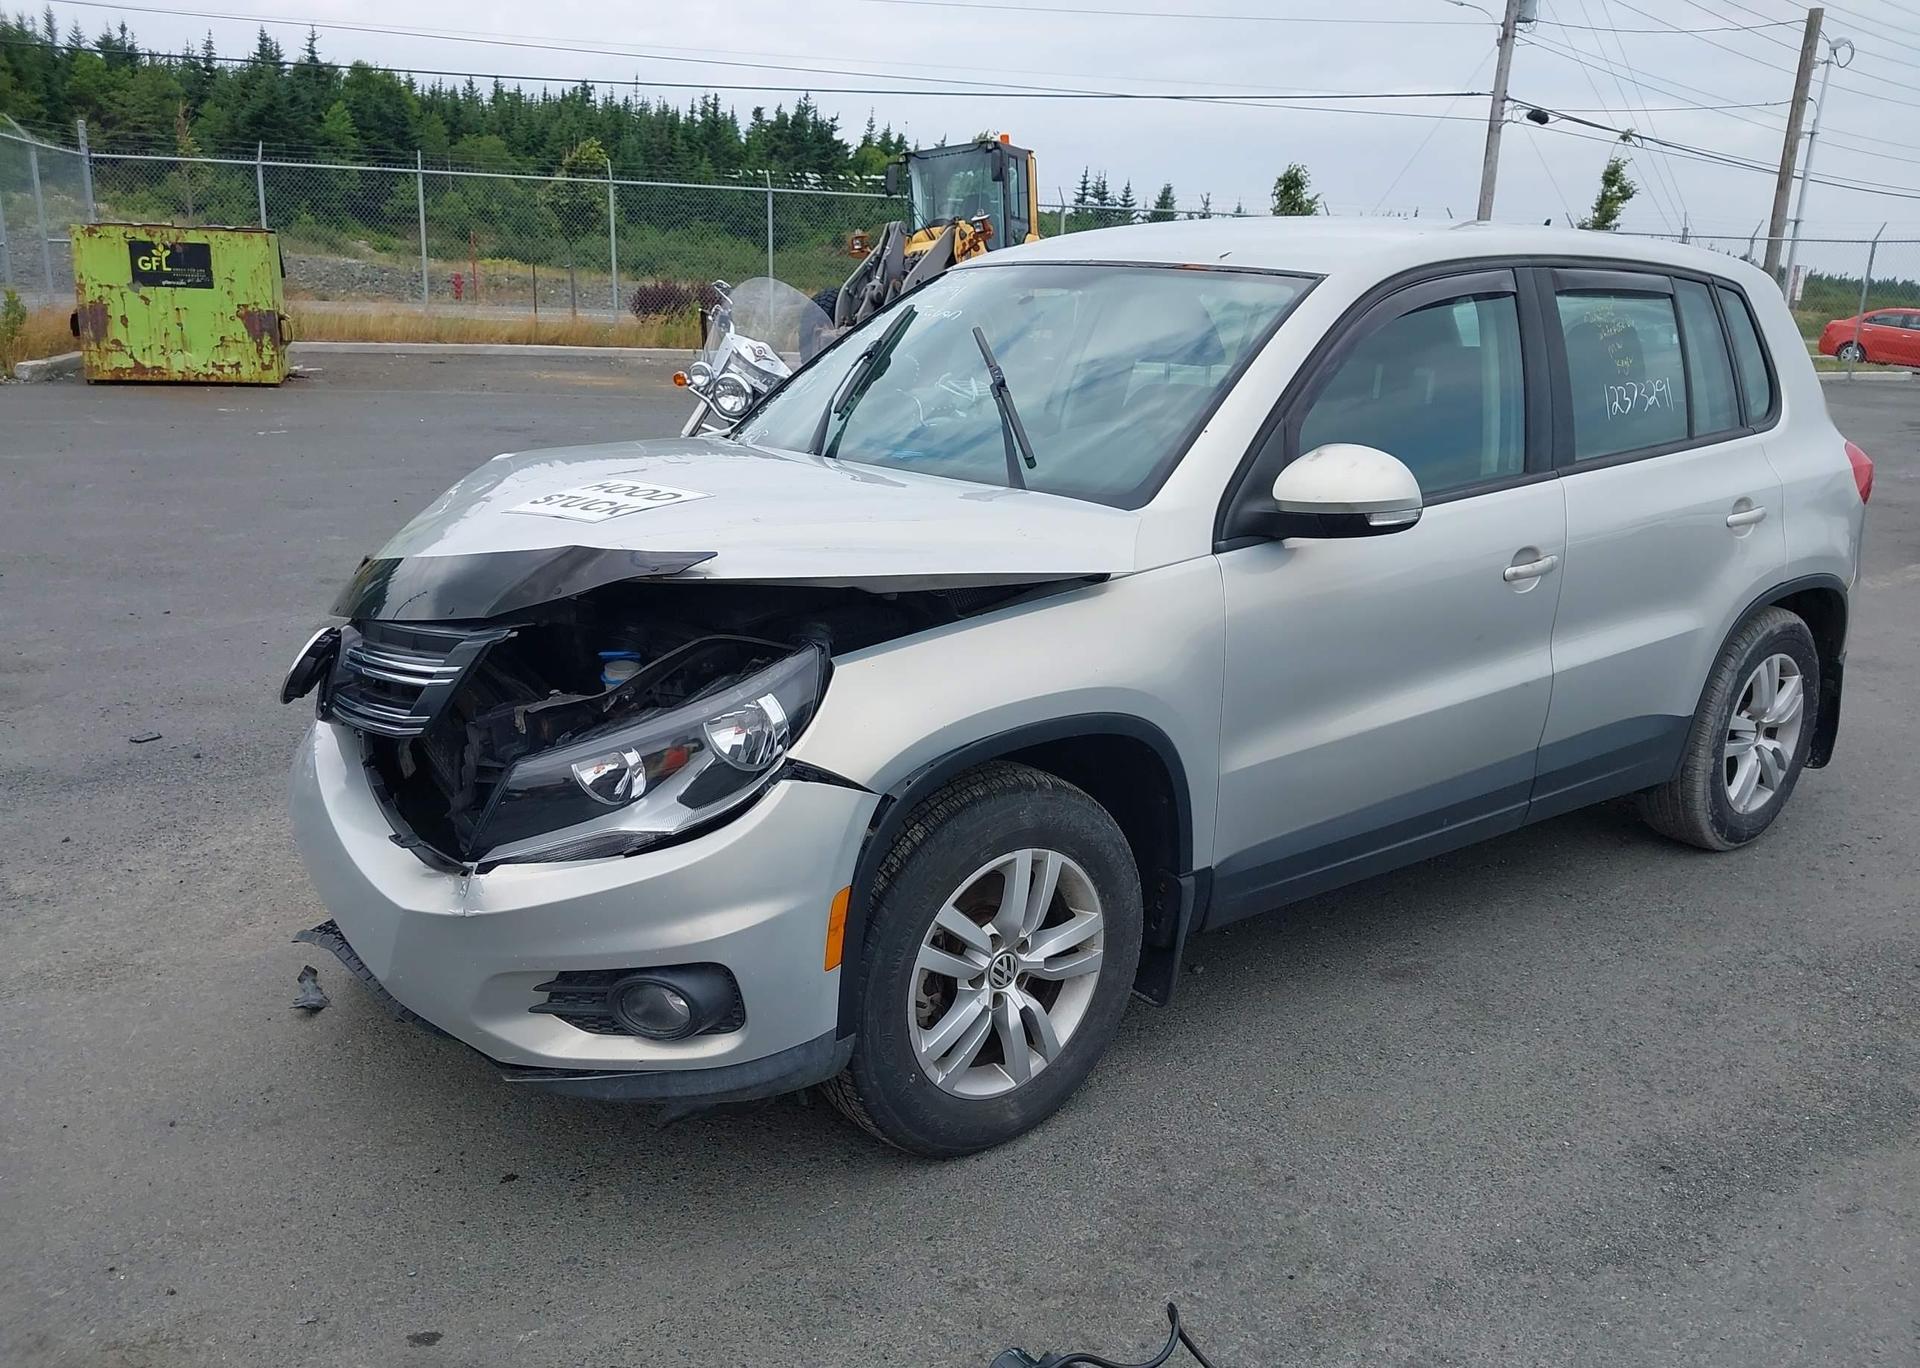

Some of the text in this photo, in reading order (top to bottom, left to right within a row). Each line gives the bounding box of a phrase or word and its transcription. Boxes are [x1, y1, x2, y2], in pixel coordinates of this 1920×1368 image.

[137, 249, 172, 273] GFL
[582, 481, 683, 501] HOOD
[529, 493, 641, 516] STUCK
